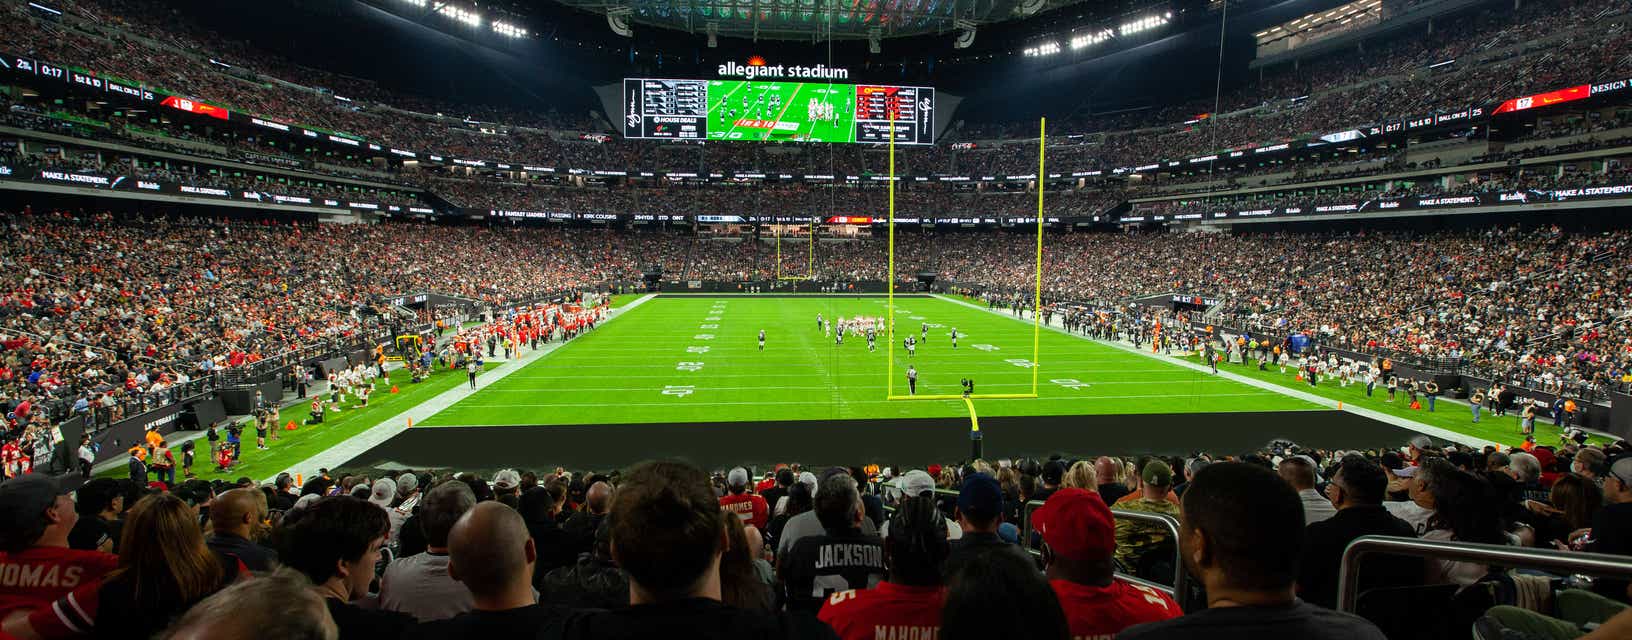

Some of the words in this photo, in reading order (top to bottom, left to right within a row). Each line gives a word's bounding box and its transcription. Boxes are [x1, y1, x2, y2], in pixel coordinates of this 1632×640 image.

[41, 65, 62, 77] 0:17
[718, 61, 784, 79] allegiant
[788, 63, 849, 79] stadium
[1591, 80, 1627, 94] DESIGN
[144, 91, 153, 100] 25
[1438, 114, 1452, 122] BALL
[1472, 108, 1482, 117] 25
[1386, 123, 1400, 132] 0:17
[42, 171, 63, 180] MAKE
[1555, 189, 1577, 197] MAKE
[1585, 185, 1632, 196] STATEMENT.
[720, 501, 753, 512] MAHOMES
[815, 543, 883, 569] JACKSON
